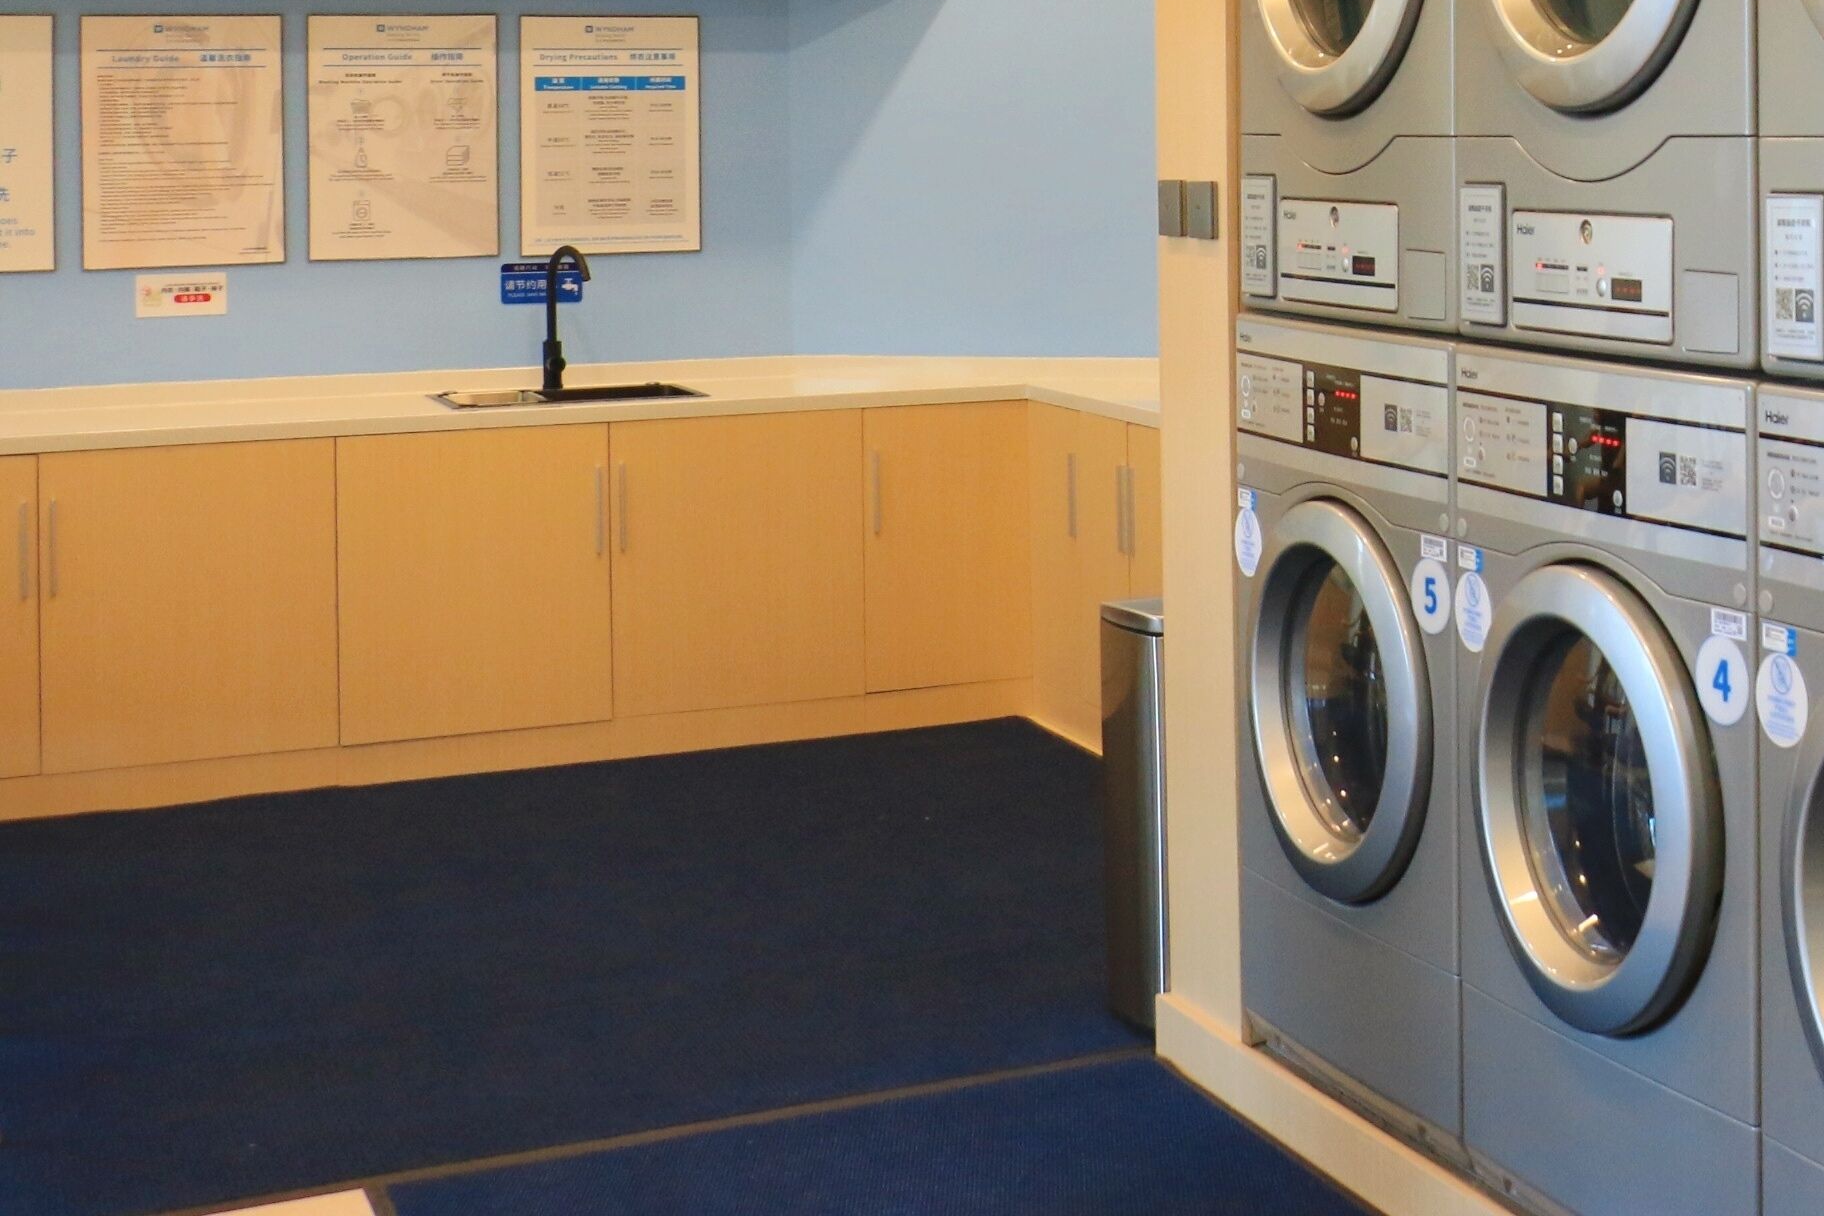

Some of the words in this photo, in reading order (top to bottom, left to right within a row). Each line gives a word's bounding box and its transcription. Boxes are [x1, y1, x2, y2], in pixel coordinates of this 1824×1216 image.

[342, 53, 386, 62] Operation
[387, 53, 413, 61] Guide
[539, 53, 567, 62] Drying
[569, 53, 618, 61] Precautions
[1516, 224, 1535, 236] Haier
[1764, 410, 1788, 426] Haier
[1422, 576, 1439, 616] 5
[1712, 660, 1732, 703] 4
